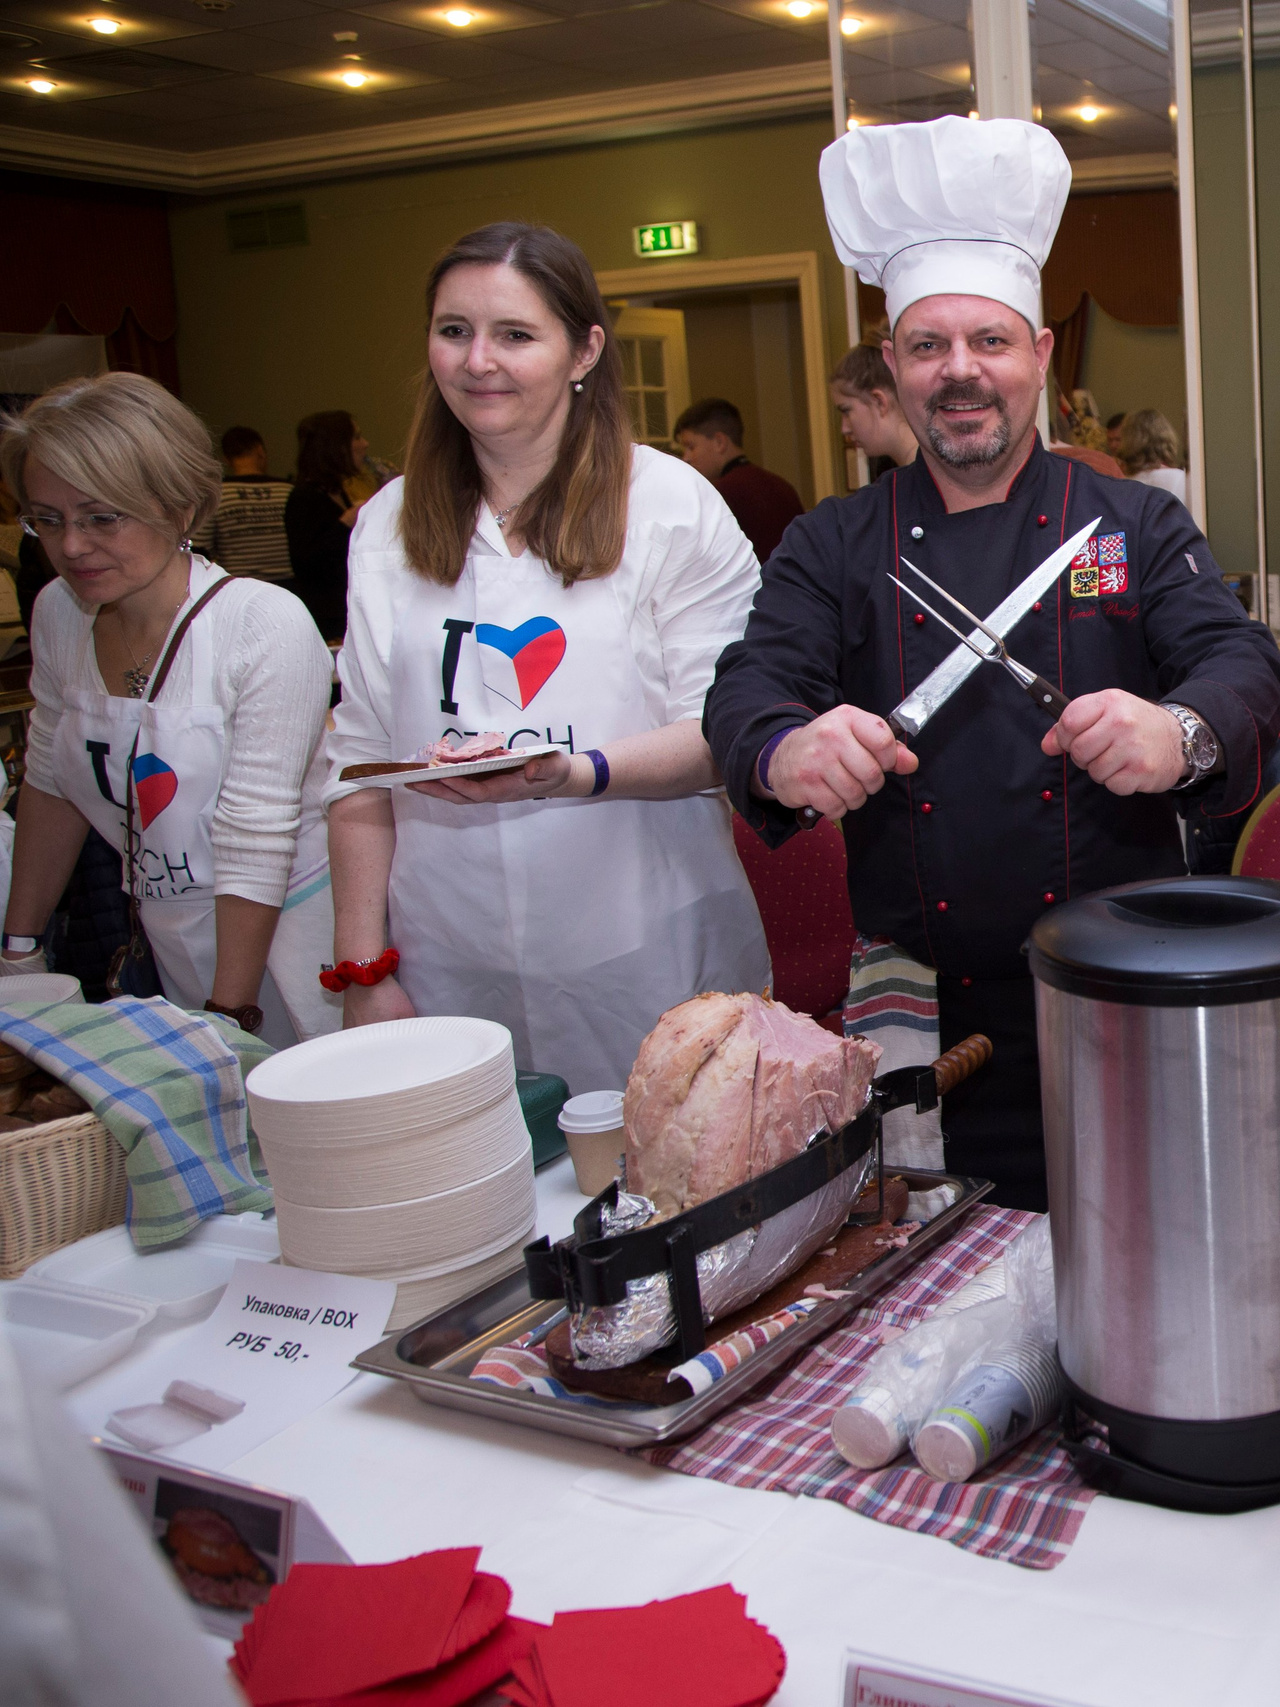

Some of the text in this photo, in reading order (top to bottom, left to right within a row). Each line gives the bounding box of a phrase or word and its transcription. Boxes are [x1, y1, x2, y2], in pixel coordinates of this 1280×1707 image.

[440, 618, 475, 716] I
[242, 1294, 310, 1322] Упаковка
[321, 1308, 359, 1329] BOX
[226, 1331, 272, 1353] РУБ
